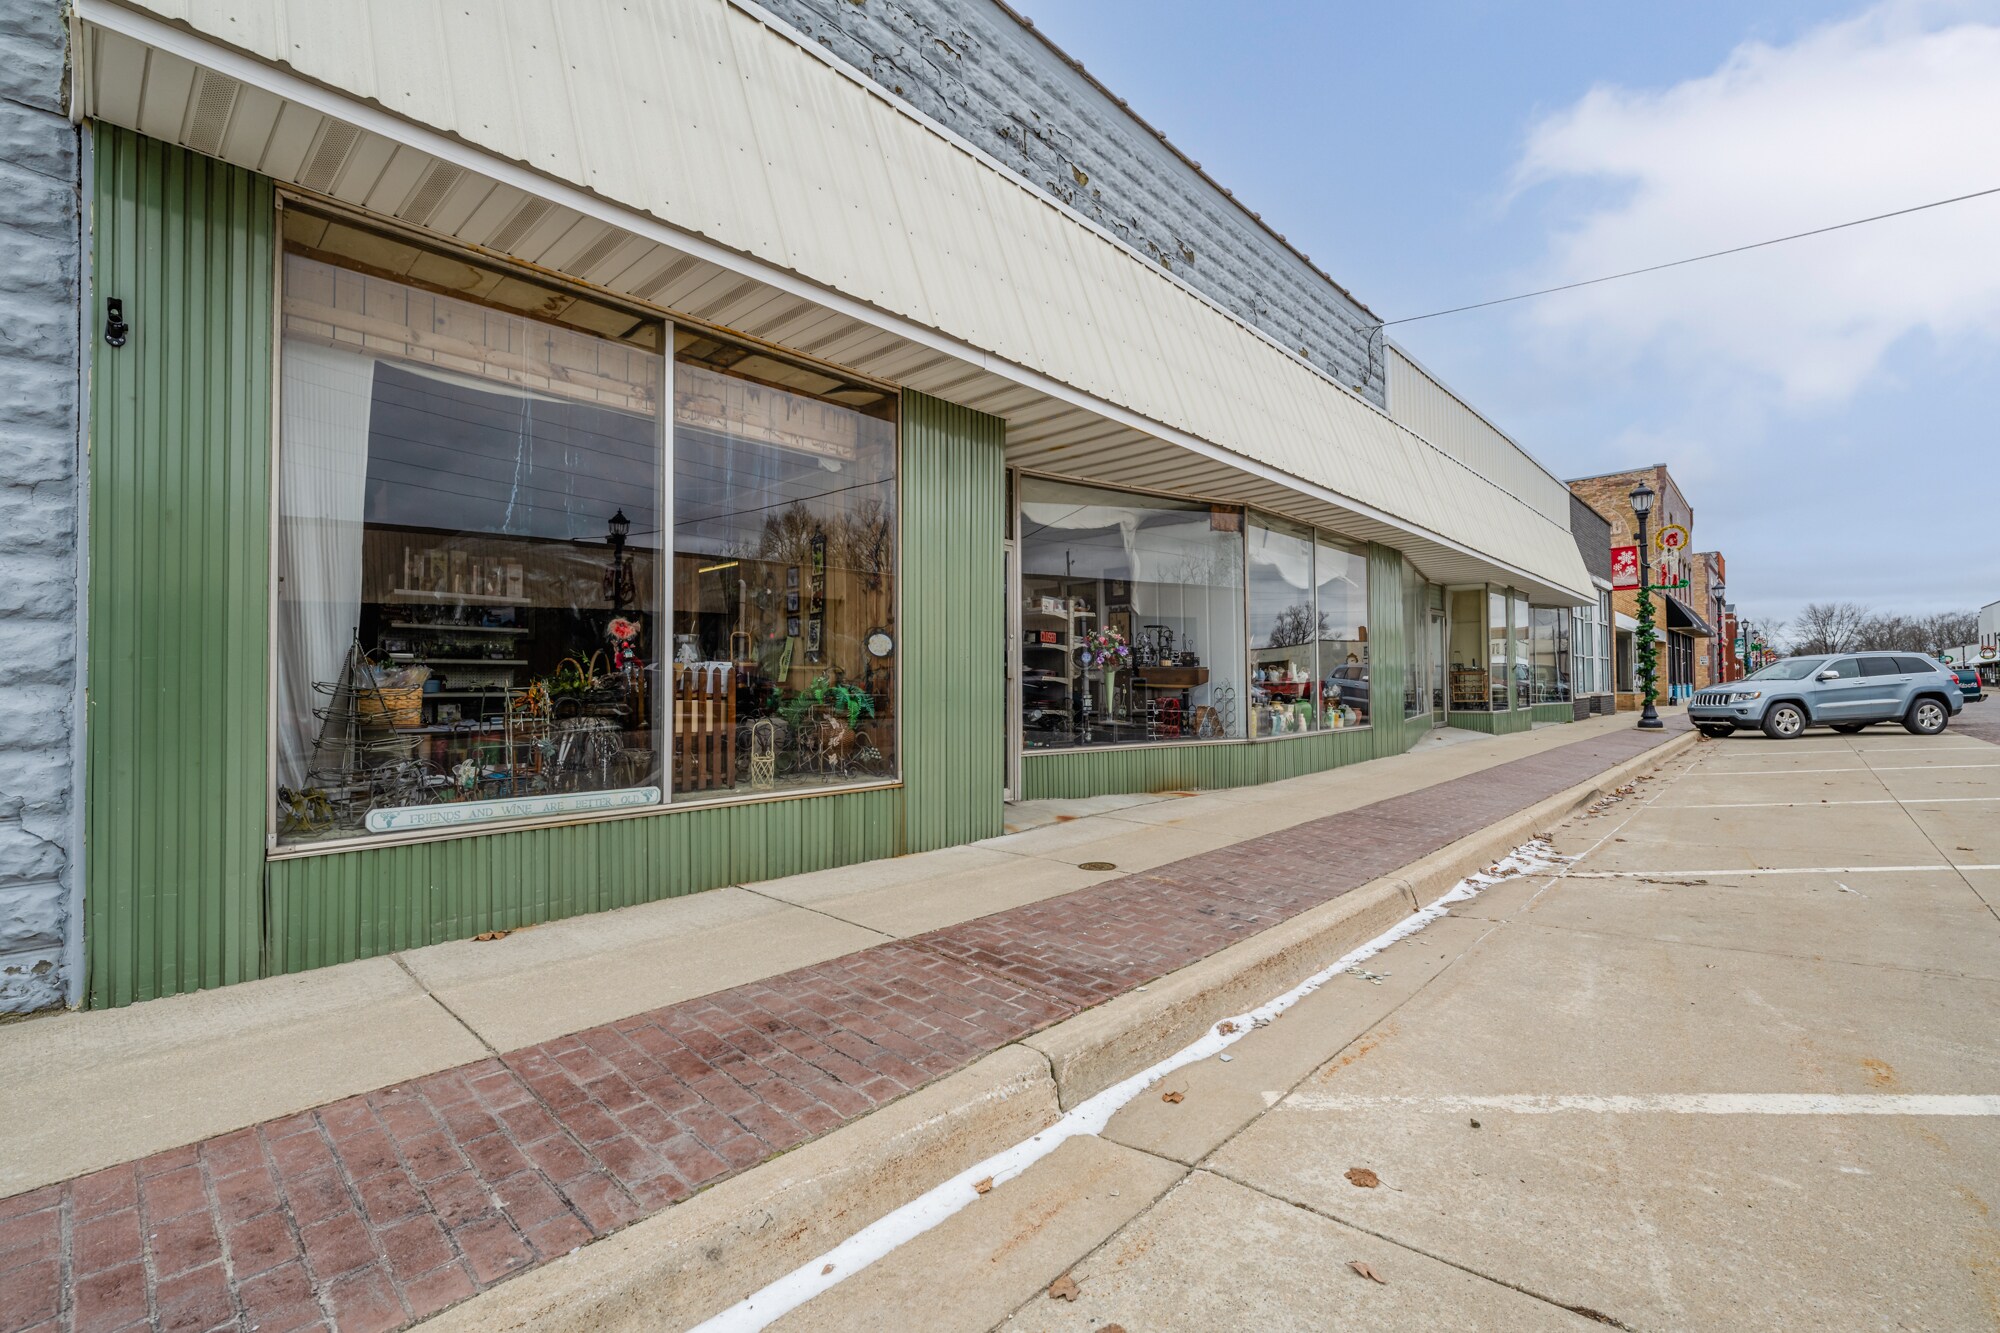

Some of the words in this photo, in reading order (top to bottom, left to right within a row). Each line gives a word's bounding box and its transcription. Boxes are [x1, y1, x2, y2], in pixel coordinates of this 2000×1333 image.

[1040, 631, 1057, 643] CLOSED
[410, 811, 461, 825] FRIENDS
[468, 808, 494, 819] AND
[501, 804, 532, 816] WINE
[543, 801, 564, 811] ARE
[575, 797, 613, 809] BETTER
[621, 795, 640, 804] OLD
